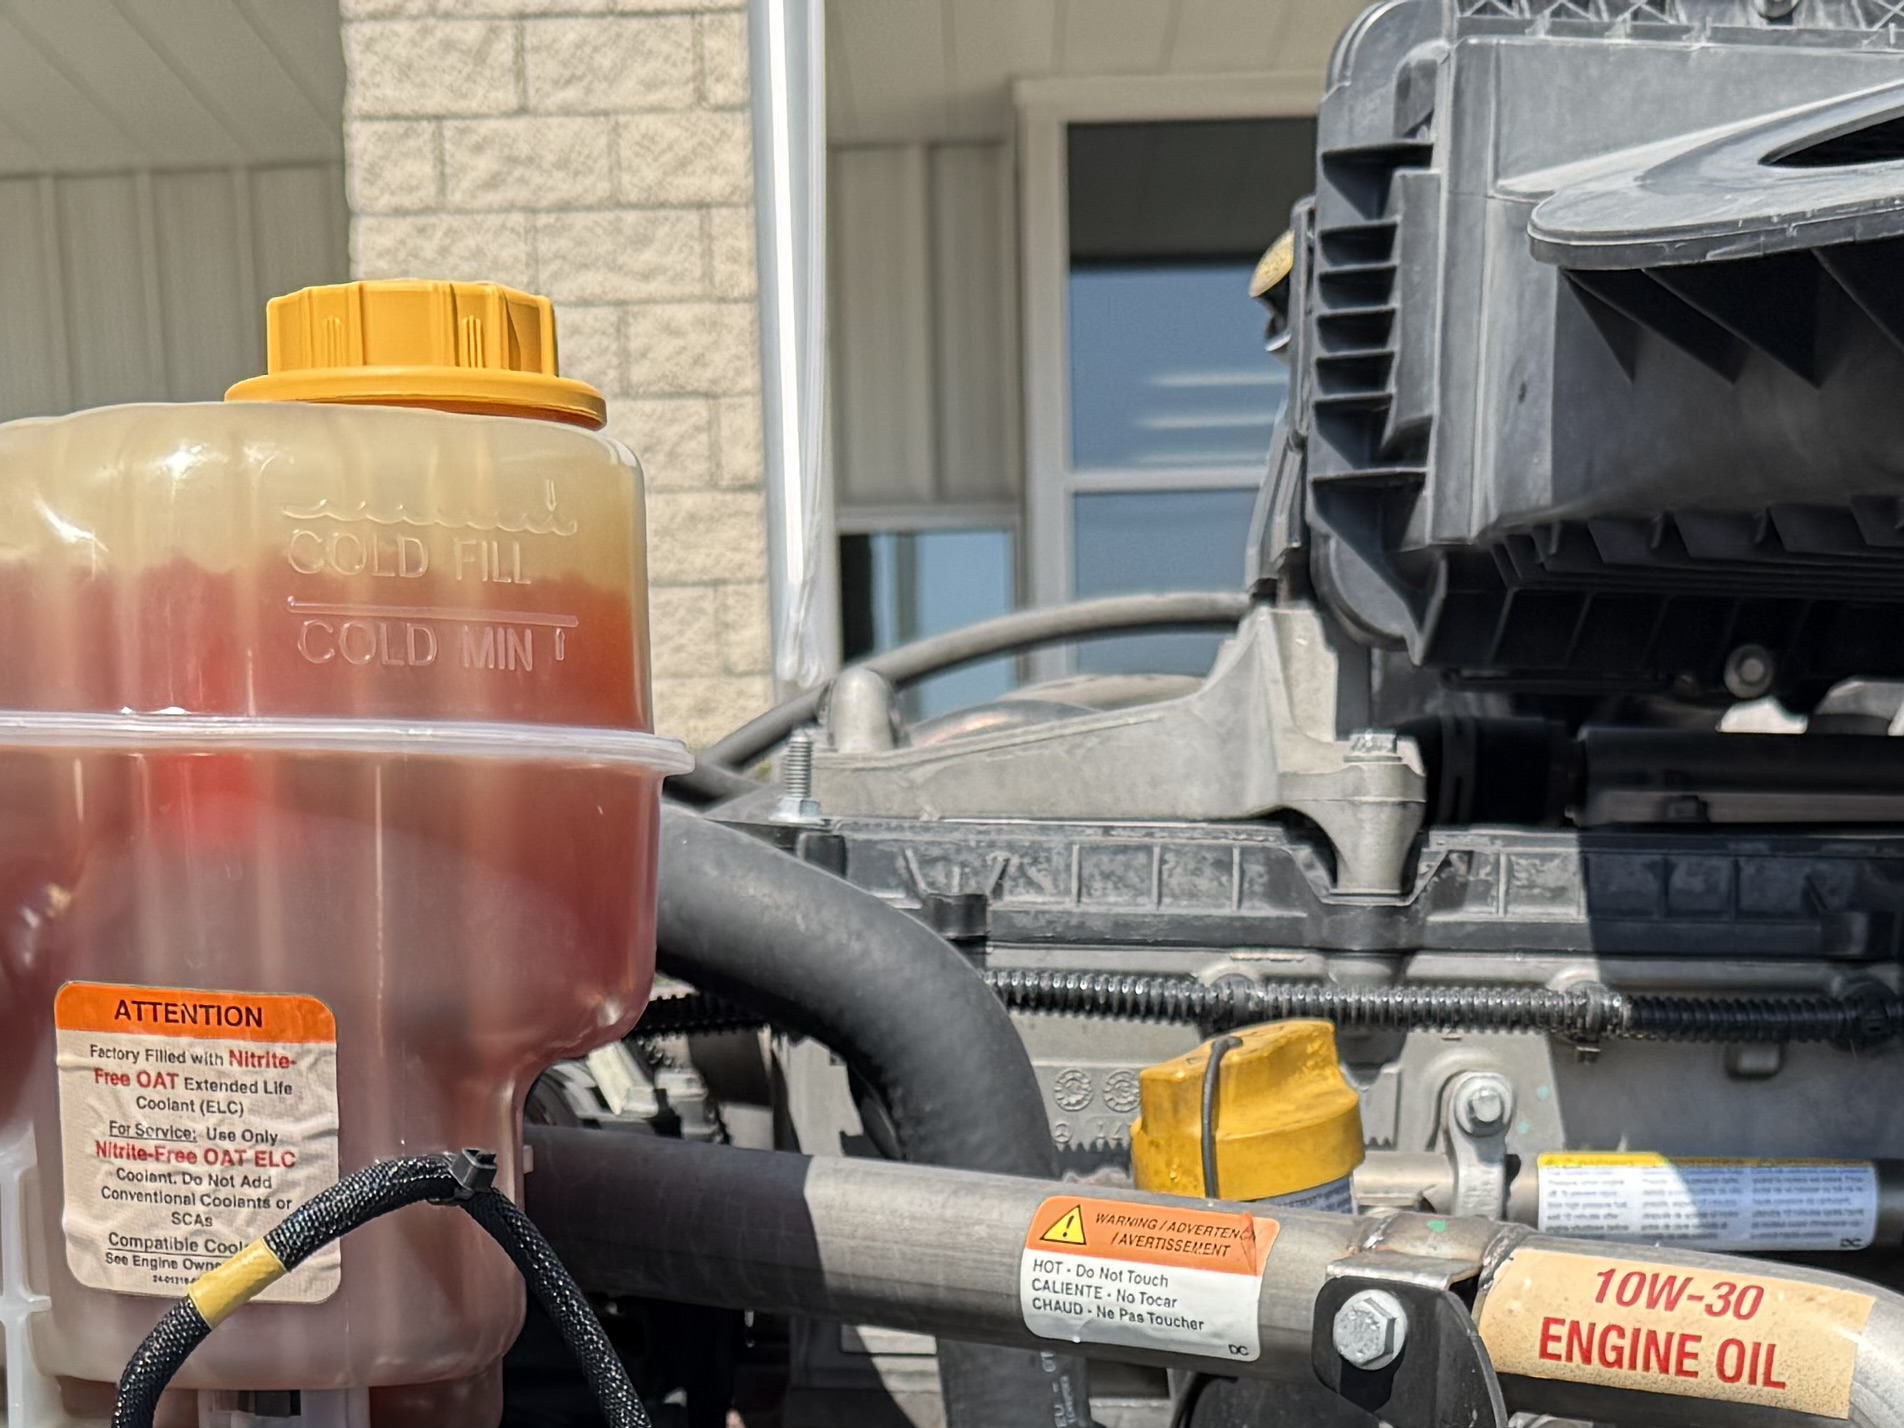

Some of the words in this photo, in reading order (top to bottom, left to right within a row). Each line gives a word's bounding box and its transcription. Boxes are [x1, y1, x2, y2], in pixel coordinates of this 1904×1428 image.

[287, 529, 429, 579] COLD
[455, 538, 533, 585] FILL
[297, 619, 437, 666] COLD
[462, 626, 534, 671] MIN
[114, 999, 263, 1028] ATTENTION
[90, 1045, 139, 1064] Factory
[145, 1048, 186, 1066] Filled
[190, 1051, 224, 1066] with
[229, 1050, 297, 1070] Nitrite-
[94, 1068, 130, 1087] Free
[136, 1072, 179, 1091] OAT
[184, 1077, 258, 1094] Extended
[264, 1080, 293, 1095] Life
[136, 1096, 196, 1114] Coolant
[200, 1099, 244, 1118] (ELC)
[109, 1121, 132, 1138] For
[135, 1123, 198, 1141] Service:
[206, 1127, 235, 1142] Use
[241, 1129, 278, 1146] Only
[96, 1140, 198, 1166] Nitrite-Free
[203, 1148, 249, 1166] OAT
[254, 1150, 297, 1168] ELC
[116, 1168, 177, 1188] Coolant.
[182, 1173, 203, 1188] Do
[207, 1173, 236, 1188] Not
[241, 1174, 273, 1189] Add
[101, 1187, 196, 1207] Conventional
[200, 1194, 271, 1209] Coolants
[276, 1198, 292, 1210] or
[170, 1211, 213, 1228] SCAs
[1096, 1212, 1157, 1231] WARNING
[1159, 1220, 1166, 1230] /
[109, 1232, 199, 1252] Compatible
[1111, 1233, 1118, 1244] /
[1119, 1234, 1231, 1257] AVERTISSEMENT
[106, 1253, 129, 1266] See
[133, 1255, 178, 1271] Engine
[1033, 1259, 1064, 1276] HOT
[1076, 1264, 1095, 1279] Do
[1100, 1267, 1123, 1283] Not
[1128, 1270, 1168, 1288] Touch
[1032, 1279, 1103, 1300] CALIENTE
[1116, 1289, 1136, 1304] No
[1139, 1292, 1178, 1309] Tocar
[1594, 1267, 1766, 1321] 10W-30
[1032, 1298, 1083, 1315] CHAUD
[1097, 1306, 1116, 1319] Ne
[1120, 1307, 1144, 1324] Pas
[1147, 1313, 1205, 1331] Toucher
[1228, 1344, 1249, 1356] DC
[1537, 1316, 1703, 1381] ENGINE
[1715, 1340, 1789, 1391] OIL
